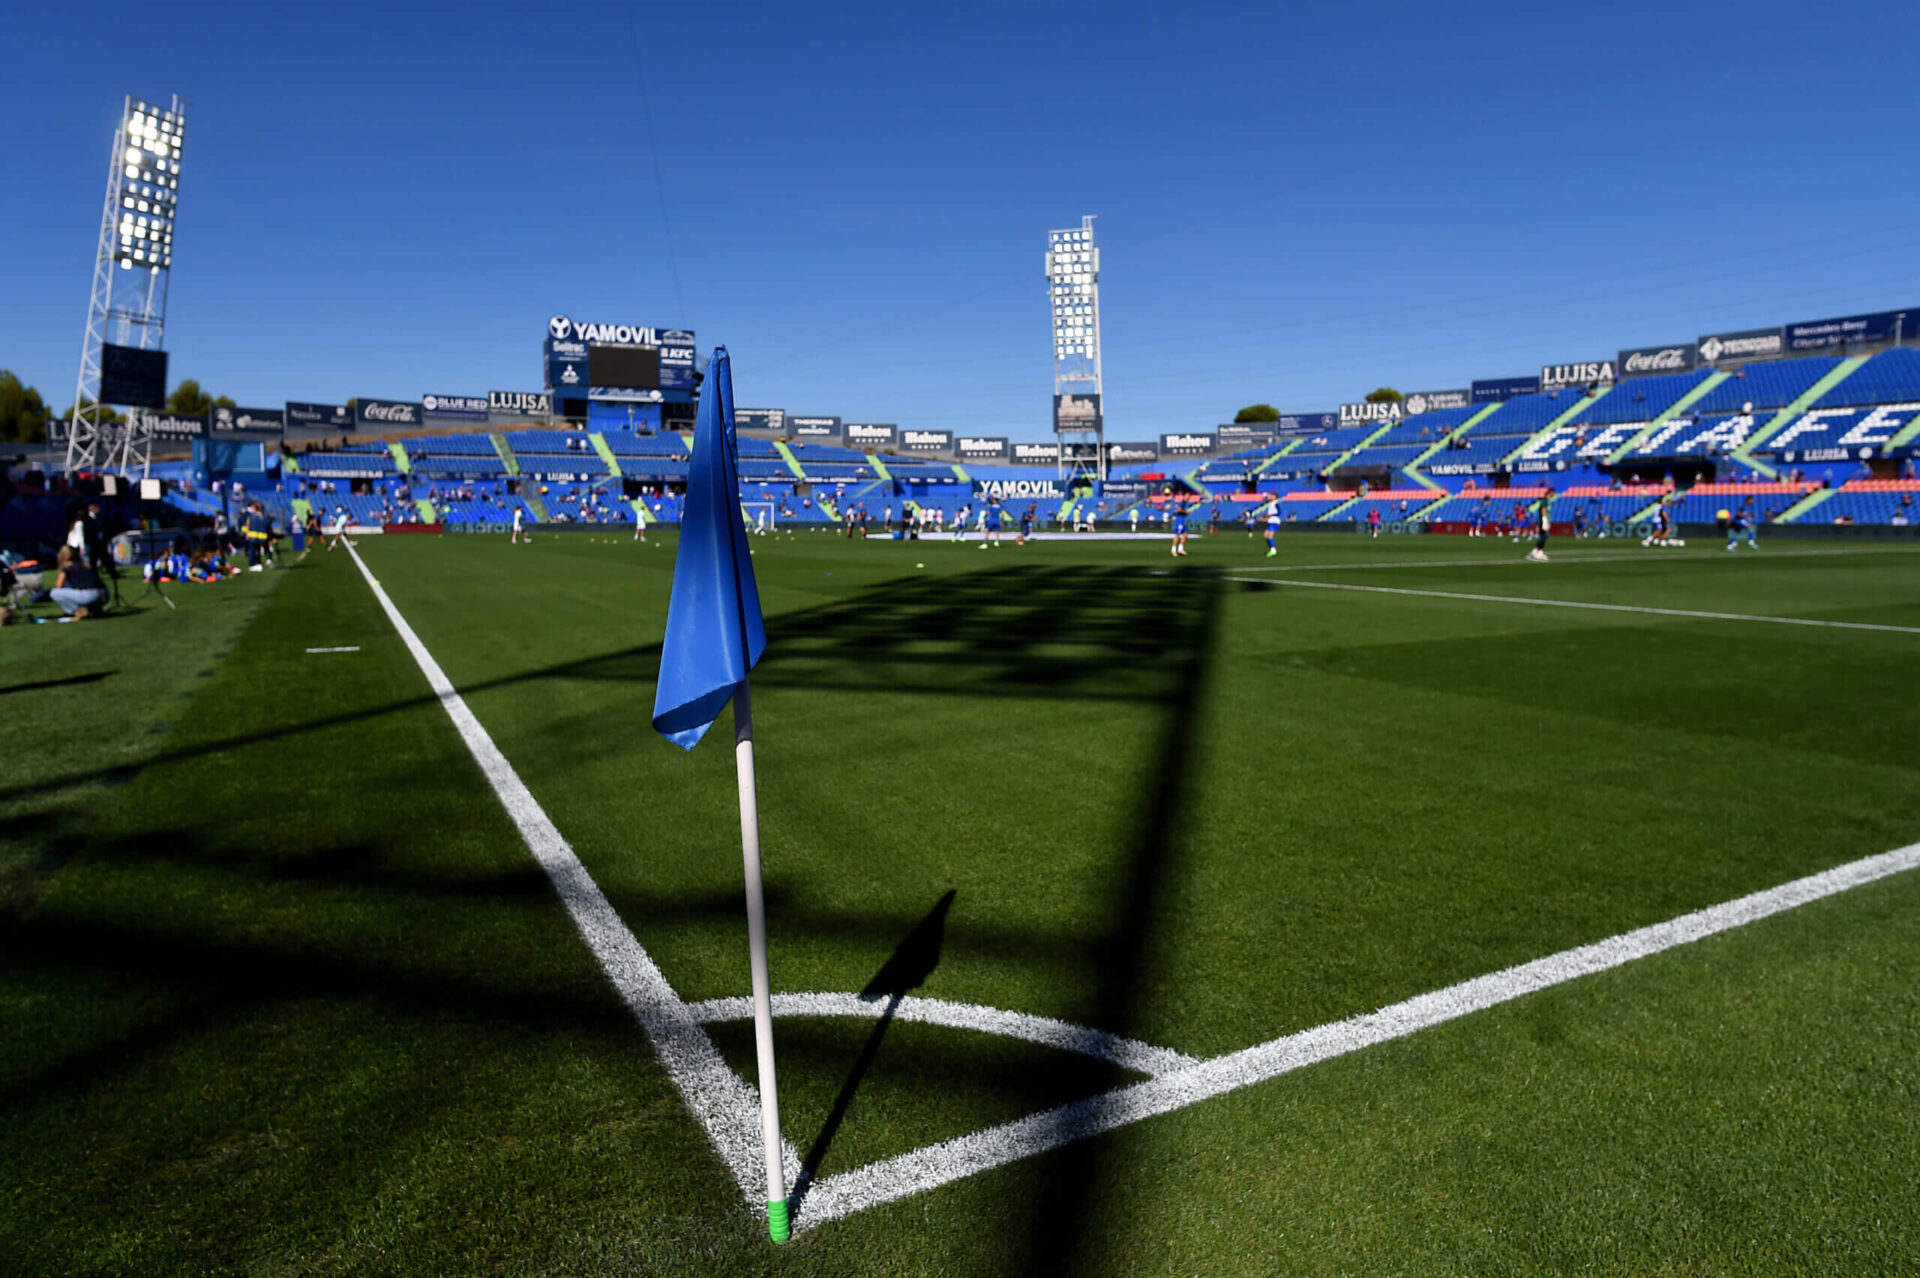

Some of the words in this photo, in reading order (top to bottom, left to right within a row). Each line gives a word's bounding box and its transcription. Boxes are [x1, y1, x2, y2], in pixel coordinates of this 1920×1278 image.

[573, 322, 662, 345] YAMOVIL
[1794, 321, 1868, 337] Mercedes-Benz
[669, 348, 694, 359] KFC
[1625, 349, 1686, 372] Coca-Cola
[1543, 363, 1614, 384] LUJISA
[437, 397, 465, 409] BLUE
[466, 399, 488, 410] RED
[490, 391, 549, 410] LUJISA
[364, 402, 415, 422] Coca-Cola
[1340, 403, 1401, 421] LUJISA
[142, 415, 202, 434] Mahou
[848, 425, 892, 437] Mahou
[904, 431, 948, 443] Mahou
[1166, 435, 1211, 448] Mahou
[960, 438, 1003, 451] Mahou
[1016, 445, 1058, 457] Mahou
[1803, 448, 1849, 461] LUJISA
[1431, 463, 1474, 475] YAMOVIL
[1518, 461, 1550, 472] LUJISA
[547, 472, 575, 481] LUJISA
[980, 480, 1059, 494] YAMOVIL
